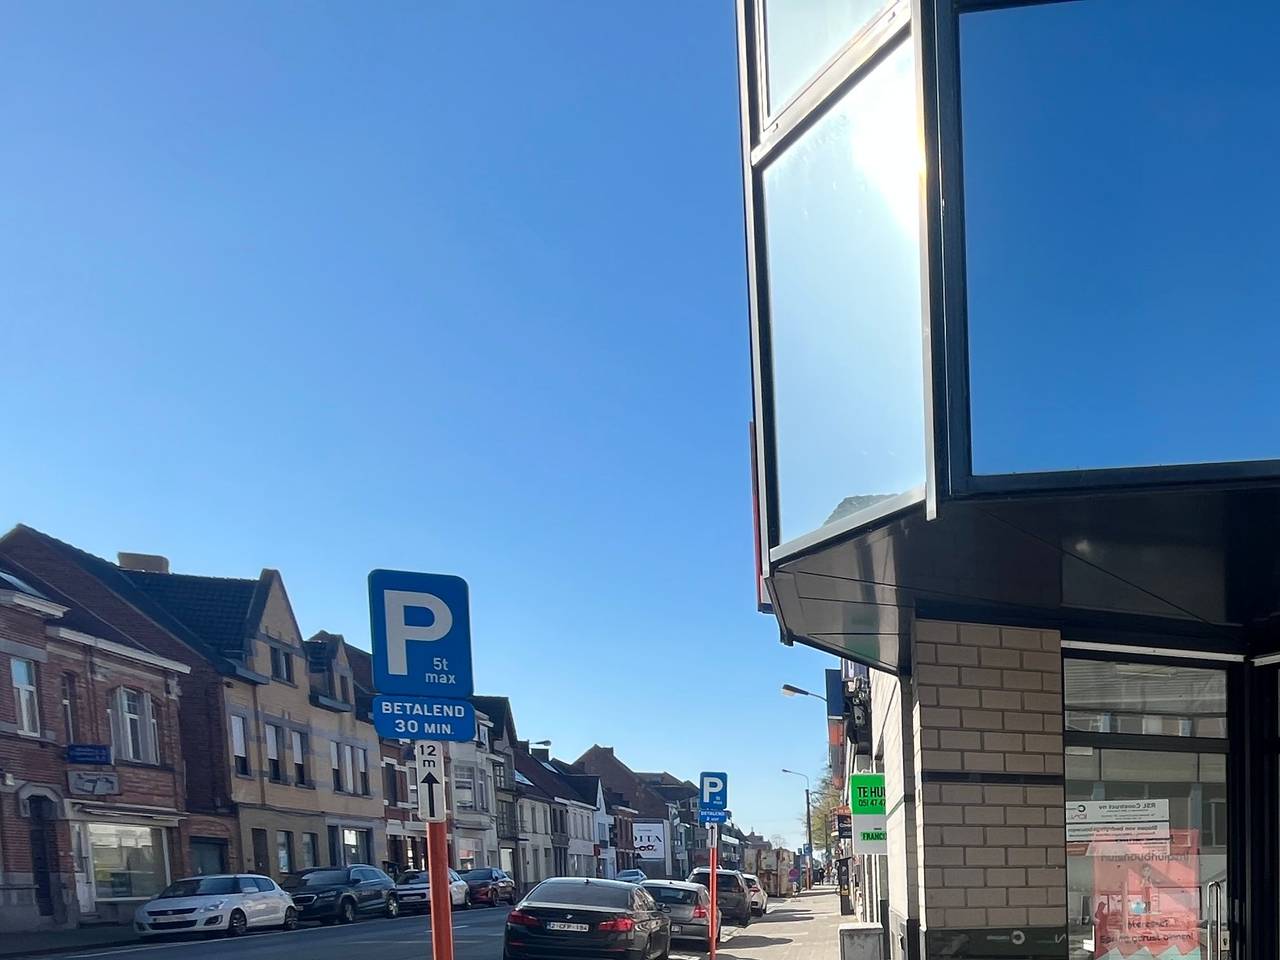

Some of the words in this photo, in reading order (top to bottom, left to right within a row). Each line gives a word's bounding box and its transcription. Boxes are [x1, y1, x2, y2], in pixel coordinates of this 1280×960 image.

[383, 589, 453, 676] P
[432, 657, 449, 671] 5t
[425, 672, 456, 684] max
[381, 702, 465, 717] BETALEND
[394, 720, 418, 733] 30
[424, 724, 454, 734] MIN.
[419, 745, 437, 756] 12
[422, 759, 436, 768] m
[703, 777, 723, 802] P
[856, 786, 868, 798] TE
[870, 786, 885, 798] HU
